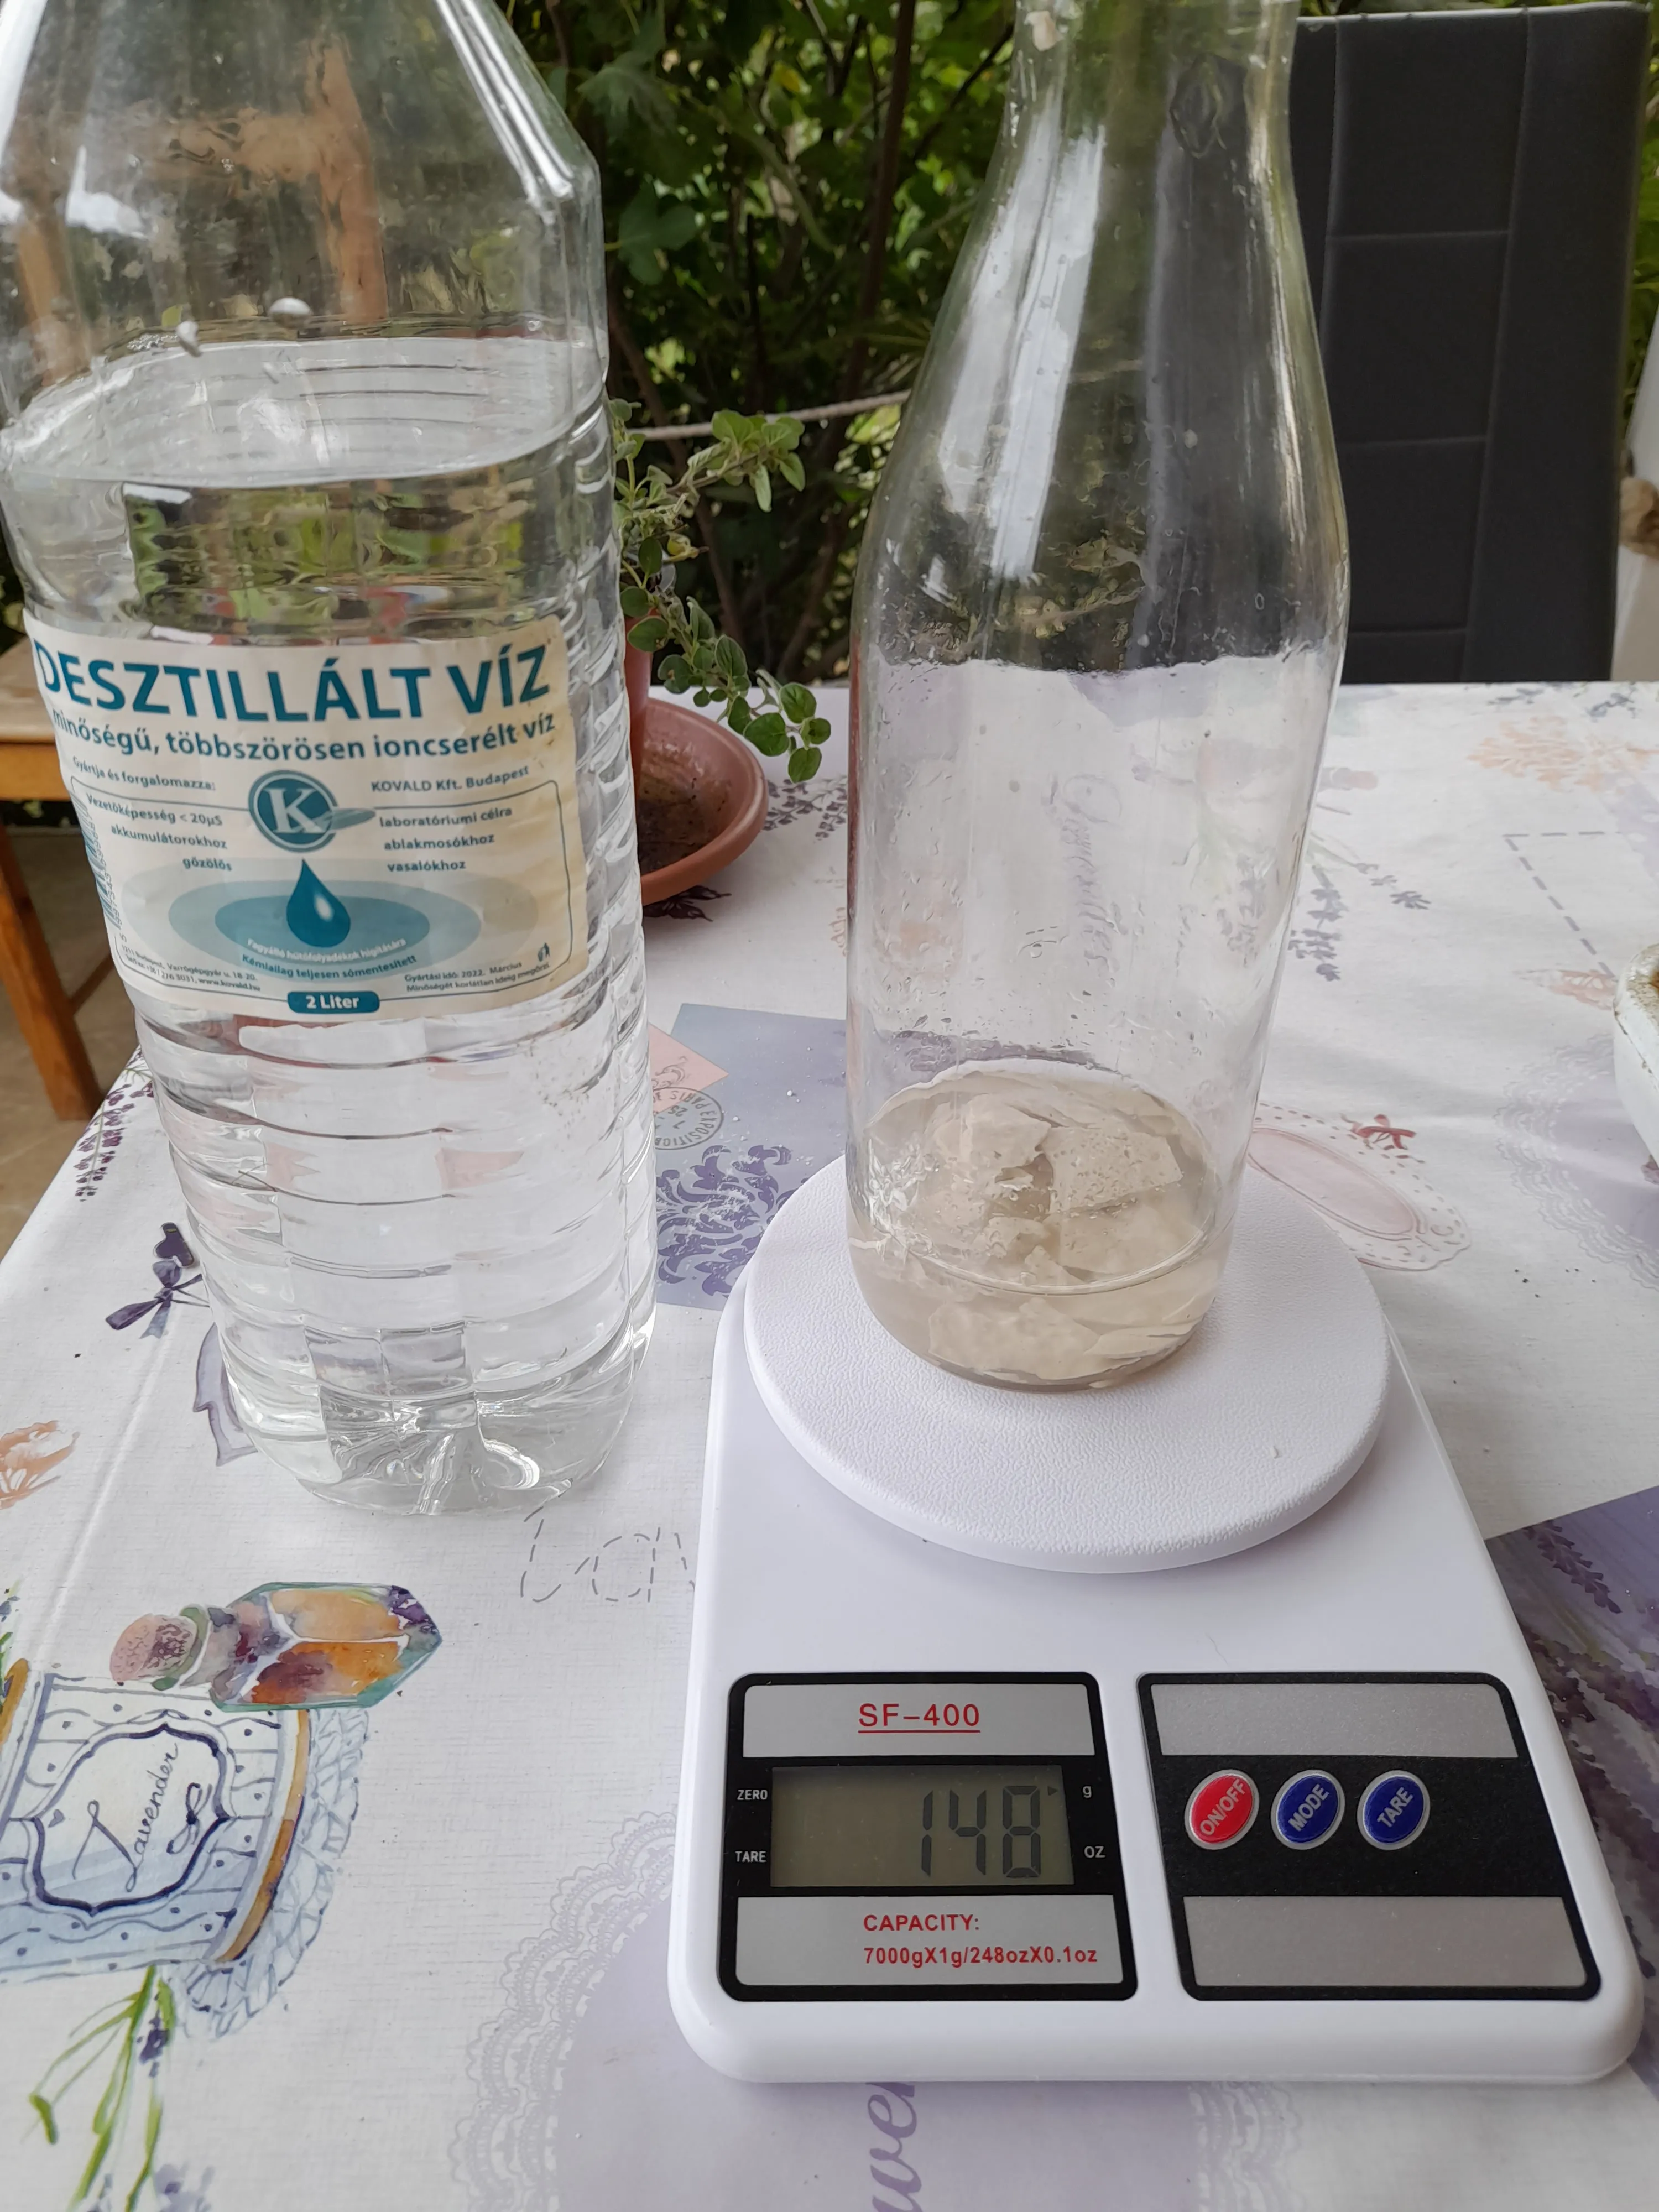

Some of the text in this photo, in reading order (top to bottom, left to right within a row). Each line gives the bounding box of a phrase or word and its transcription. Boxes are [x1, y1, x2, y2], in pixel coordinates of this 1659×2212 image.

[34, 639, 549, 721] DESZTILLÁLT VÍZ
[166, 731, 364, 761] többszörösen
[374, 723, 517, 757] ioncserélt
[523, 713, 555, 738] víz
[371, 766, 529, 792] KOVALD Kft. Budapest
[380, 807, 512, 827] laboratóriumi célra
[384, 834, 494, 850] ablakmosókhoz
[388, 860, 466, 872] vasalókhoz
[296, 968, 340, 981] teljesen
[305, 994, 359, 1009] 2 Liter
[858, 1703, 981, 1727] SF-400
[737, 1789, 768, 1801] ZERO
[1082, 1785, 1093, 1799] g
[1199, 1778, 1248, 1837] ON/OFF
[1287, 1783, 1329, 1832] MODE
[1376, 1786, 1413, 1828] TARE
[920, 1785, 1041, 1879] 148
[735, 1850, 766, 1863] TARE
[863, 1914, 979, 1932] CAPACITY:
[864, 1946, 1098, 1968] 7000gX1g/248ozX0.1oz
